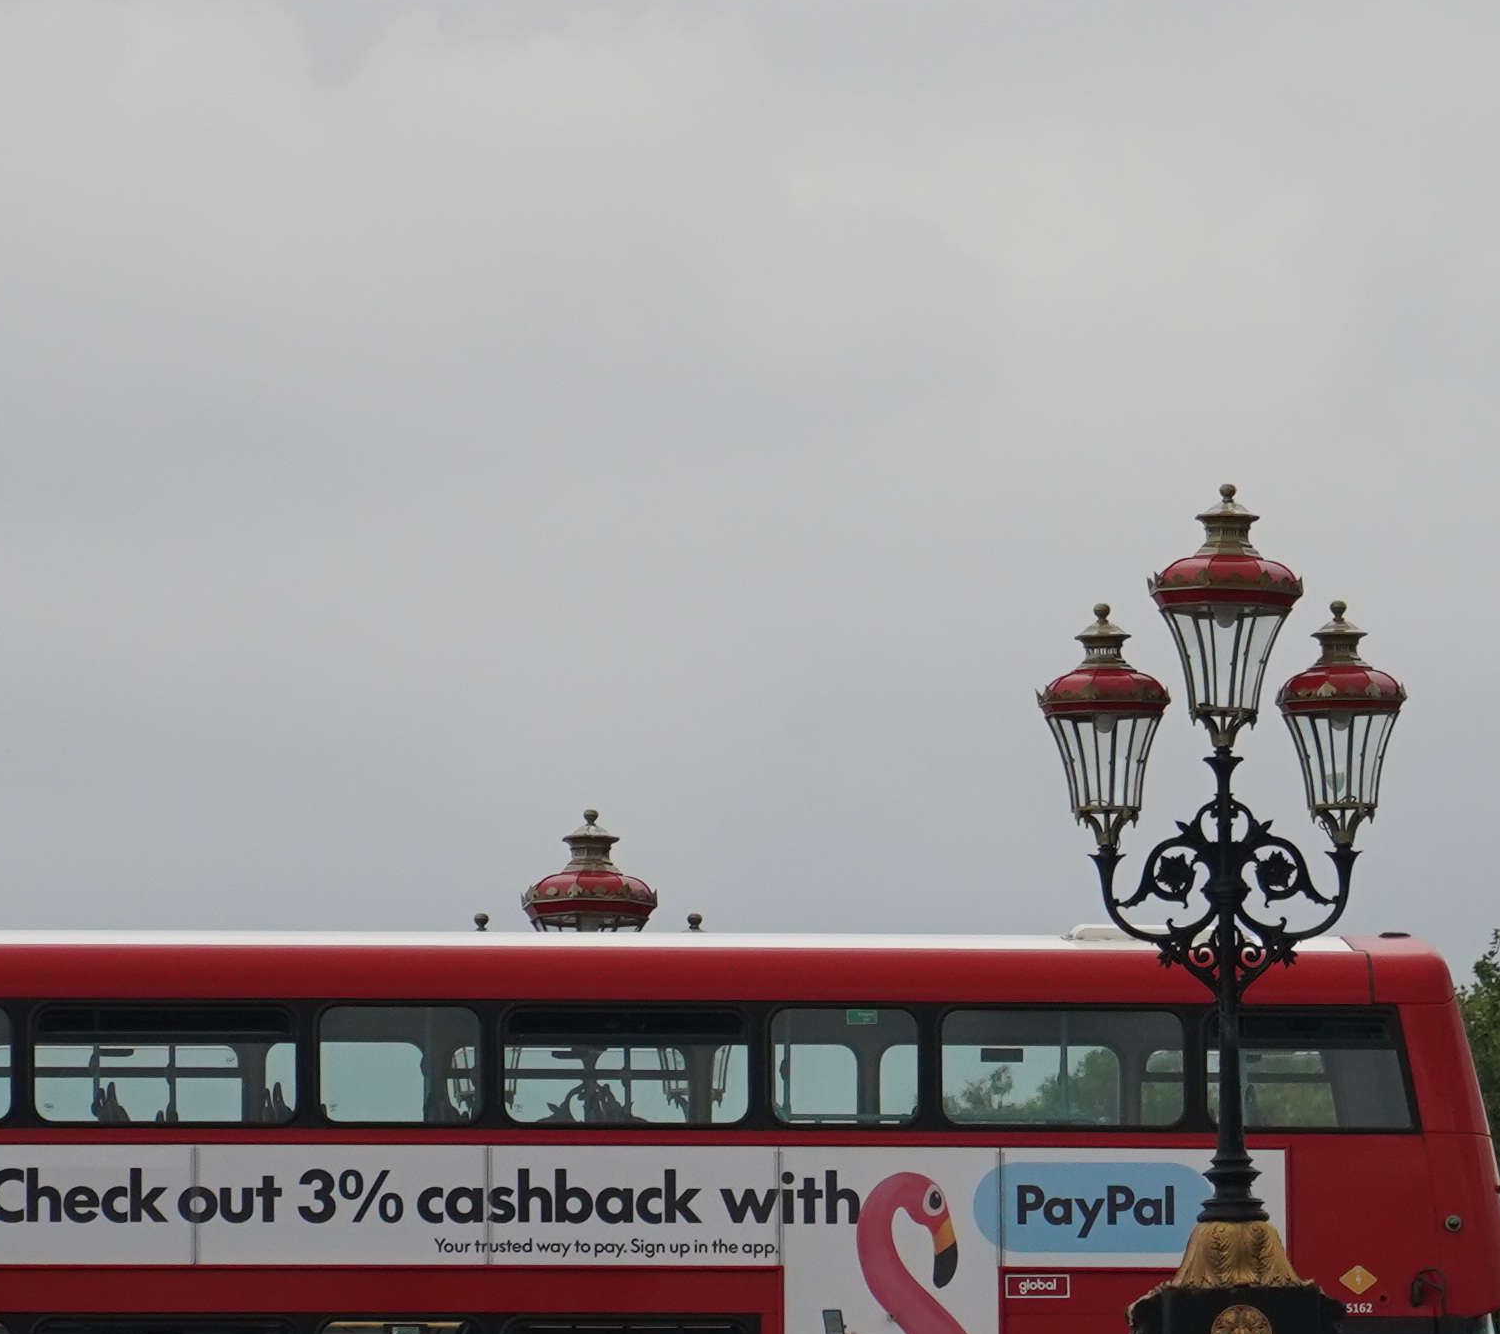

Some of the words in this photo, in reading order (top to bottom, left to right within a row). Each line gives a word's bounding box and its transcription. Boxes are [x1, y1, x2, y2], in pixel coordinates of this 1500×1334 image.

[177, 1175, 283, 1224] out
[297, 1168, 404, 1224] 3%
[416, 1168, 702, 1224] cashback
[720, 1170, 860, 1225] with
[1016, 1184, 1176, 1239] PayPal
[434, 1238, 471, 1254] Your
[474, 1237, 533, 1254] trusted
[536, 1242, 572, 1258] way
[574, 1240, 591, 1254] to
[594, 1242, 627, 1258] pay.
[631, 1238, 666, 1258] Sign
[669, 1242, 690, 1258] up
[694, 1239, 708, 1254] in
[711, 1238, 739, 1254] the
[742, 1242, 780, 1259] app.
[1018, 1278, 1058, 1295] global
